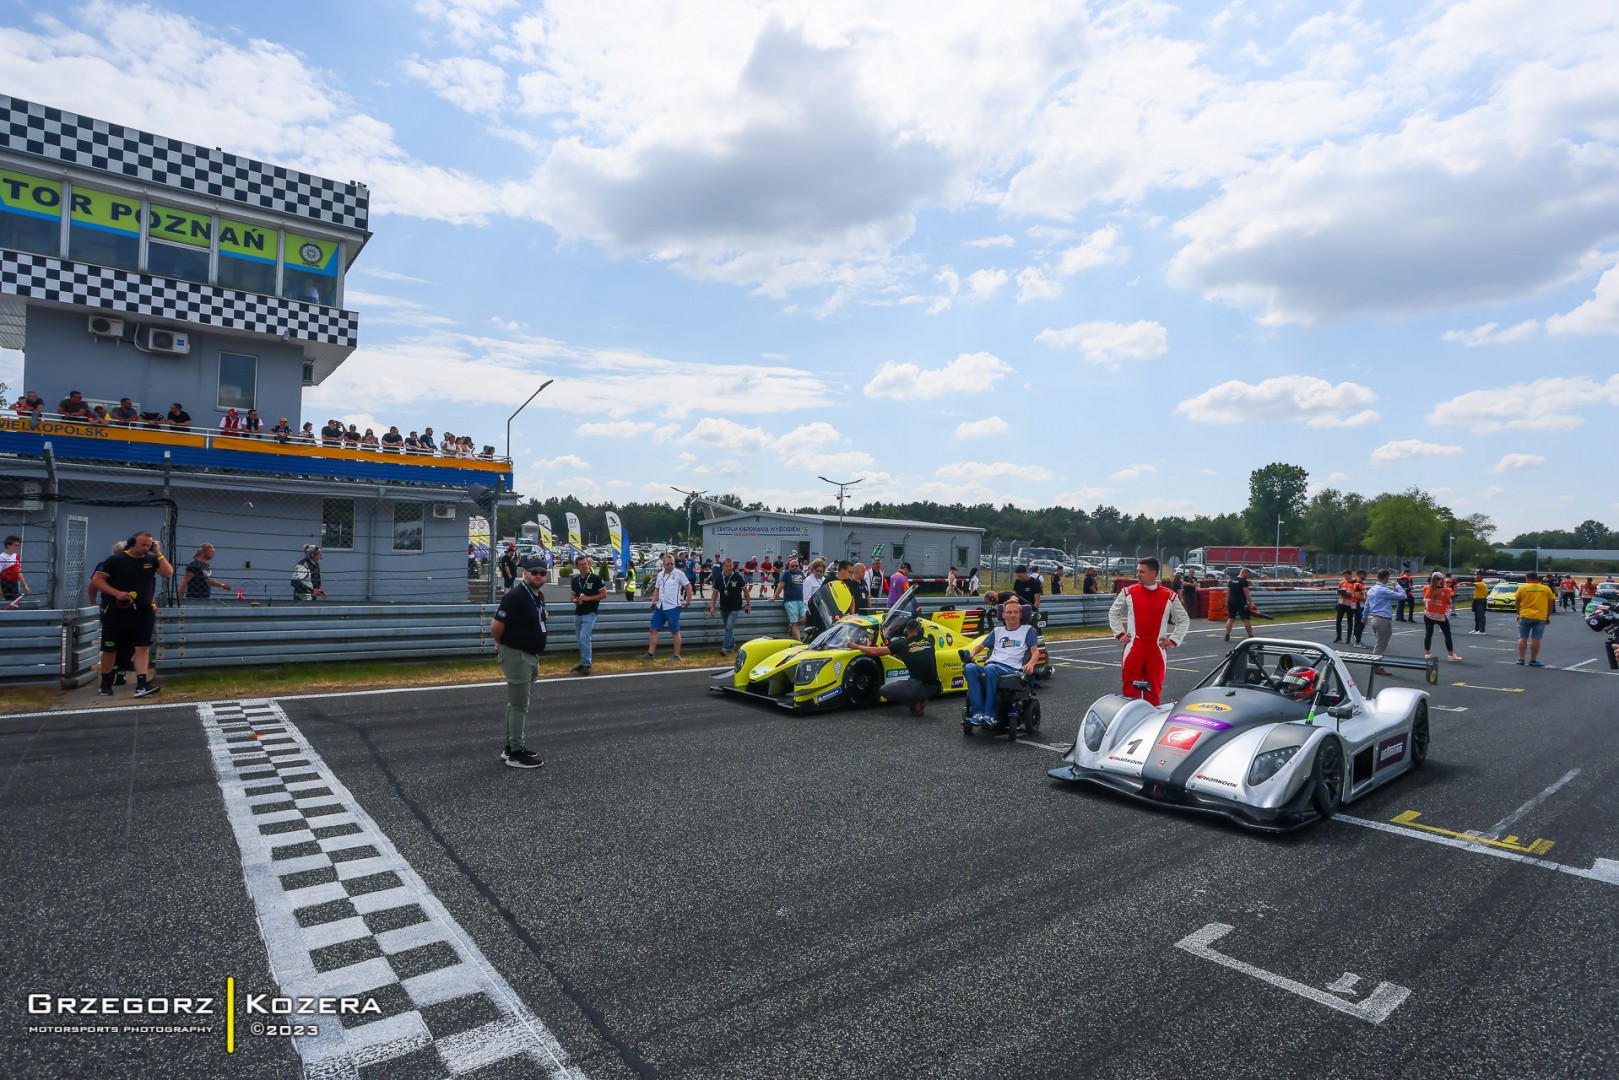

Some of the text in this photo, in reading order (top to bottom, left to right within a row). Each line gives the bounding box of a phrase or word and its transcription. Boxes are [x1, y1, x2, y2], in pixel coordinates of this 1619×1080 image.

[2, 178, 265, 251] TOR POZNAŃ
[1126, 738, 1143, 755] 1
